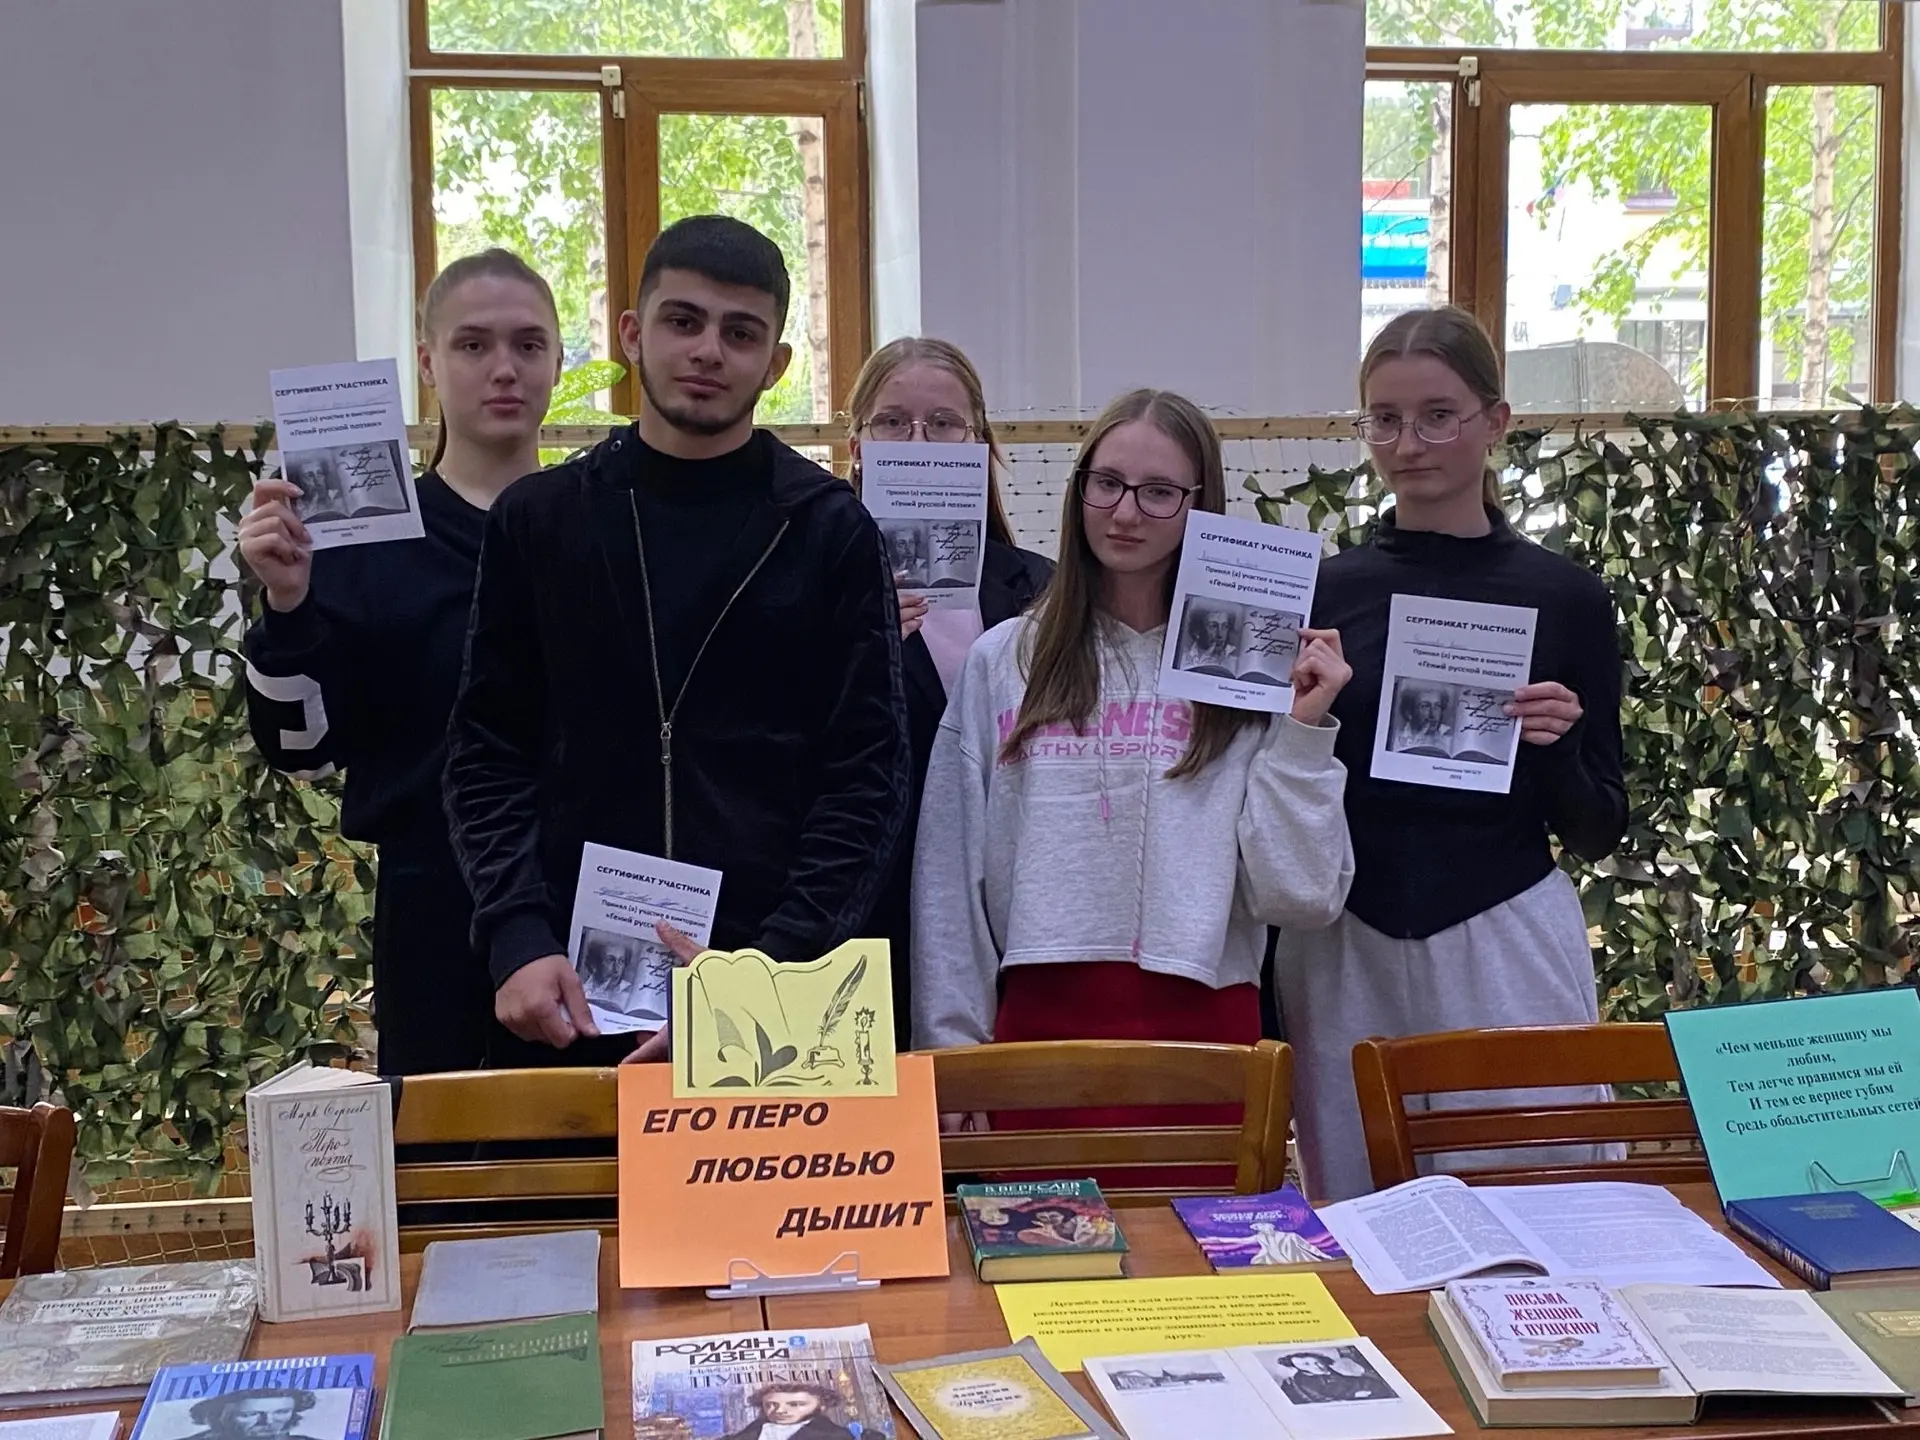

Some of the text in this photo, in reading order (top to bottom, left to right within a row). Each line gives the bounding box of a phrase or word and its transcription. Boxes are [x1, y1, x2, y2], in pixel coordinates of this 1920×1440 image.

[275, 378, 388, 397] СЕРТИФИКАТ УЧАСТНИКА
[318, 423, 349, 435] русской
[876, 459, 982, 468] СЕРТИФИКАТ УЧАСТНИКА
[917, 501, 946, 509] русской
[1200, 532, 1260, 549] СЕРТИФИКАТ
[1261, 543, 1313, 560] УЧАСТНИКА
[1237, 584, 1269, 596] русской
[1406, 615, 1528, 636] СЕРТИФИКАТ УЧАСТНИКА
[1448, 665, 1480, 675] русской
[597, 865, 711, 897] СЕРТИФИКАТ УЧАСТНИКА
[1715, 1026, 1892, 1057] «Чем меньше женщину мы
[1786, 1051, 1836, 1068] любим,
[1727, 1061, 1903, 1093] Тем легче нравимся мы ей
[1749, 1083, 1895, 1111] И тем ее вернее губим
[642, 1101, 829, 1134] ЕГО ПЕРО
[1726, 1115, 1768, 1135] Средь
[1770, 1103, 1885, 1129] обольстительных
[300, 1127, 351, 1155] Перо
[685, 1149, 895, 1185] ЛЮБОВЬЮ
[775, 1200, 933, 1239] ДЫШИТ
[1503, 1292, 1568, 1305] ПИСЬМА
[1509, 1307, 1584, 1321] ЖЕНЩИН
[1510, 1322, 1600, 1337] К ПУШКИНУ
[211, 1356, 328, 1374] СПУТНИКИ
[689, 1347, 790, 1365] ГАЗЕТА
[164, 1364, 366, 1400] ПУШКИНА
[690, 1369, 834, 1388] ПУШКИН
